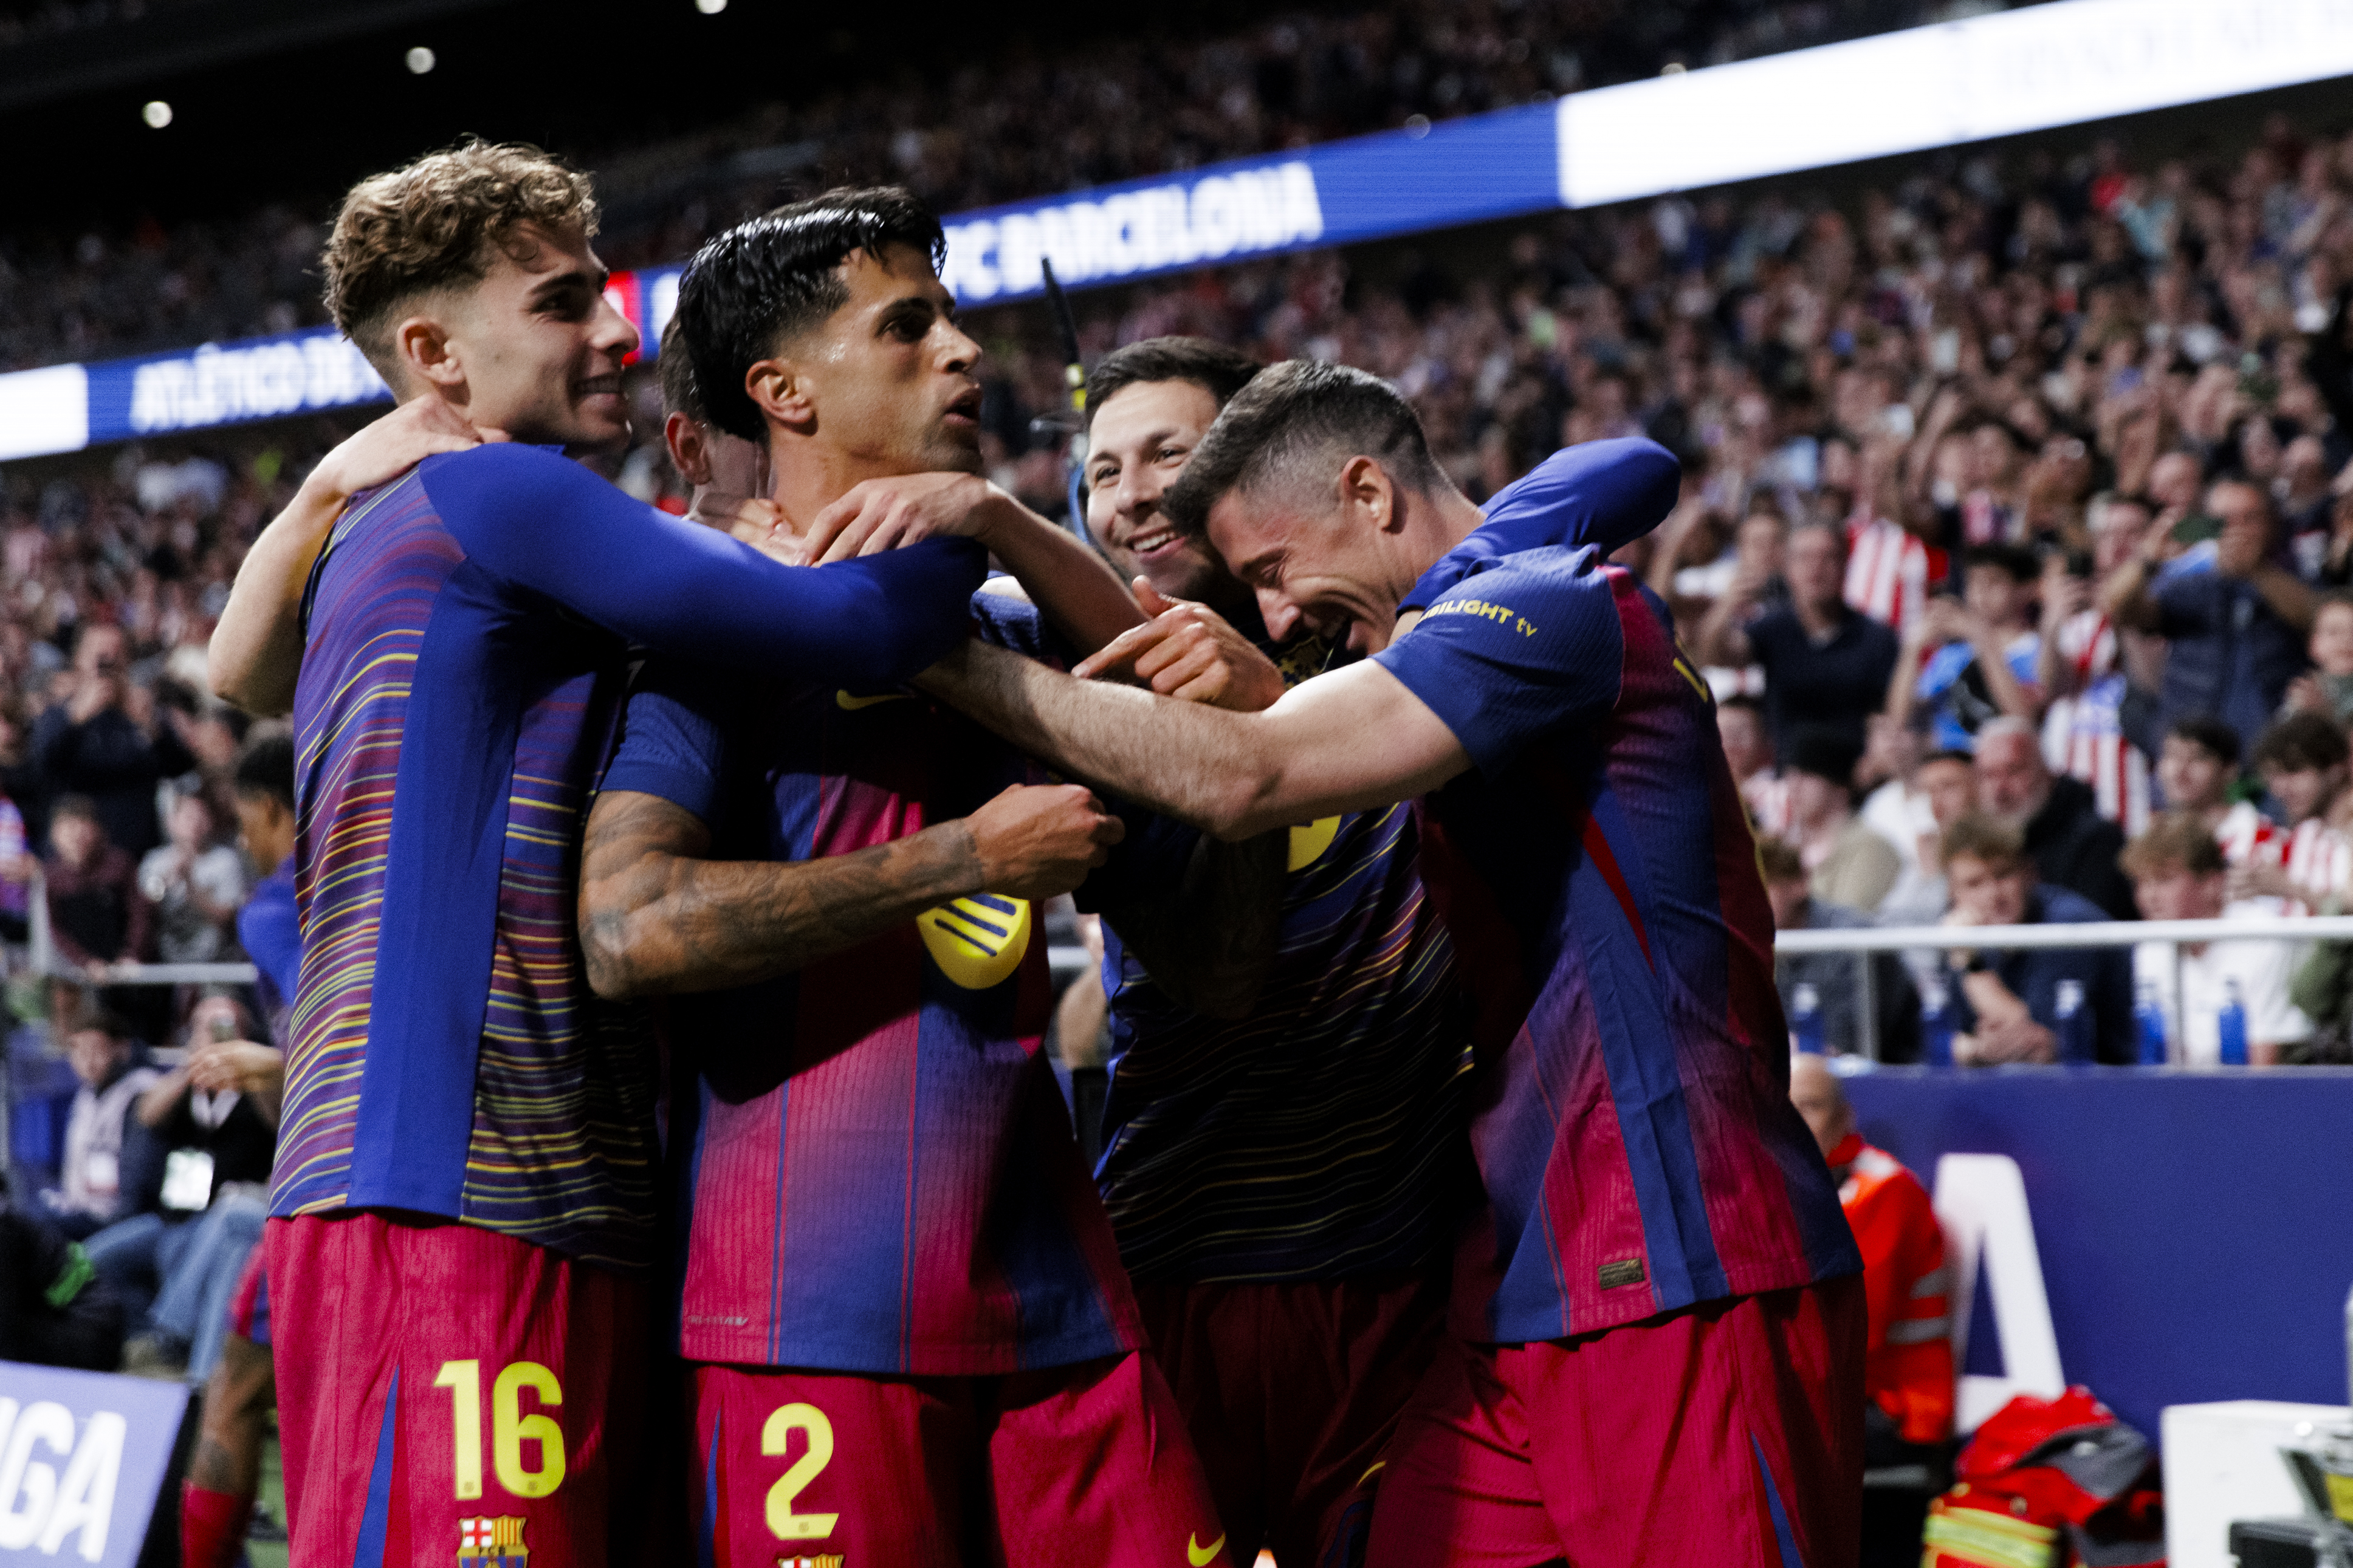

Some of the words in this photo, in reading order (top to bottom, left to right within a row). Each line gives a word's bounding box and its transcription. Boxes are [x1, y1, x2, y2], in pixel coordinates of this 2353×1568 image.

[998, 159, 1325, 295] BARCELONA
[1516, 617, 1539, 637] tv
[433, 1359, 566, 1501] 16
[761, 1402, 840, 1541] 2
